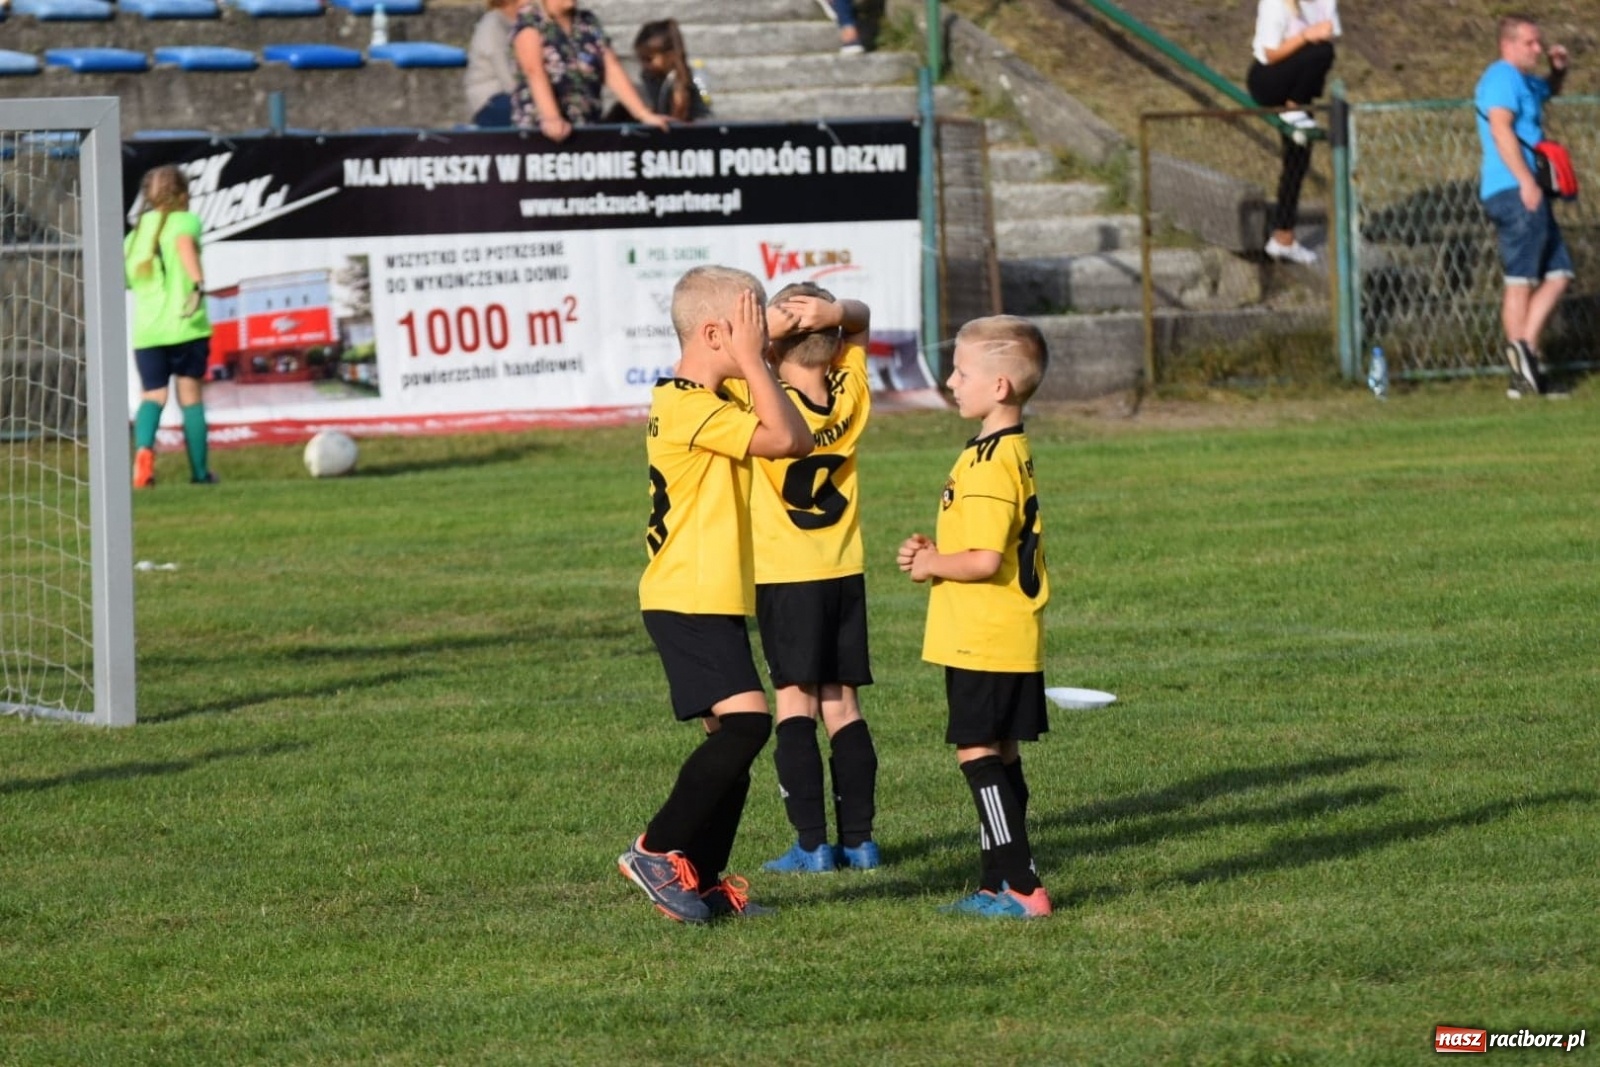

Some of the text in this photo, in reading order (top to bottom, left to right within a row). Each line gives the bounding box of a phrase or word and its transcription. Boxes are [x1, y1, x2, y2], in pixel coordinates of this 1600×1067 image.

[343, 140, 906, 190] NAJWIĘKSZY W REGIONIE SALON PODŁÓG I DRZWI
[519, 187, 742, 217] www.ruckzuck-partner.pl
[385, 241, 564, 268] WSZYSTKO CO POTRZEBNE
[385, 278, 407, 294] DO
[525, 265, 569, 283] DOMU
[397, 303, 509, 358] 1000
[401, 354, 585, 390] powierzchni handlowej
